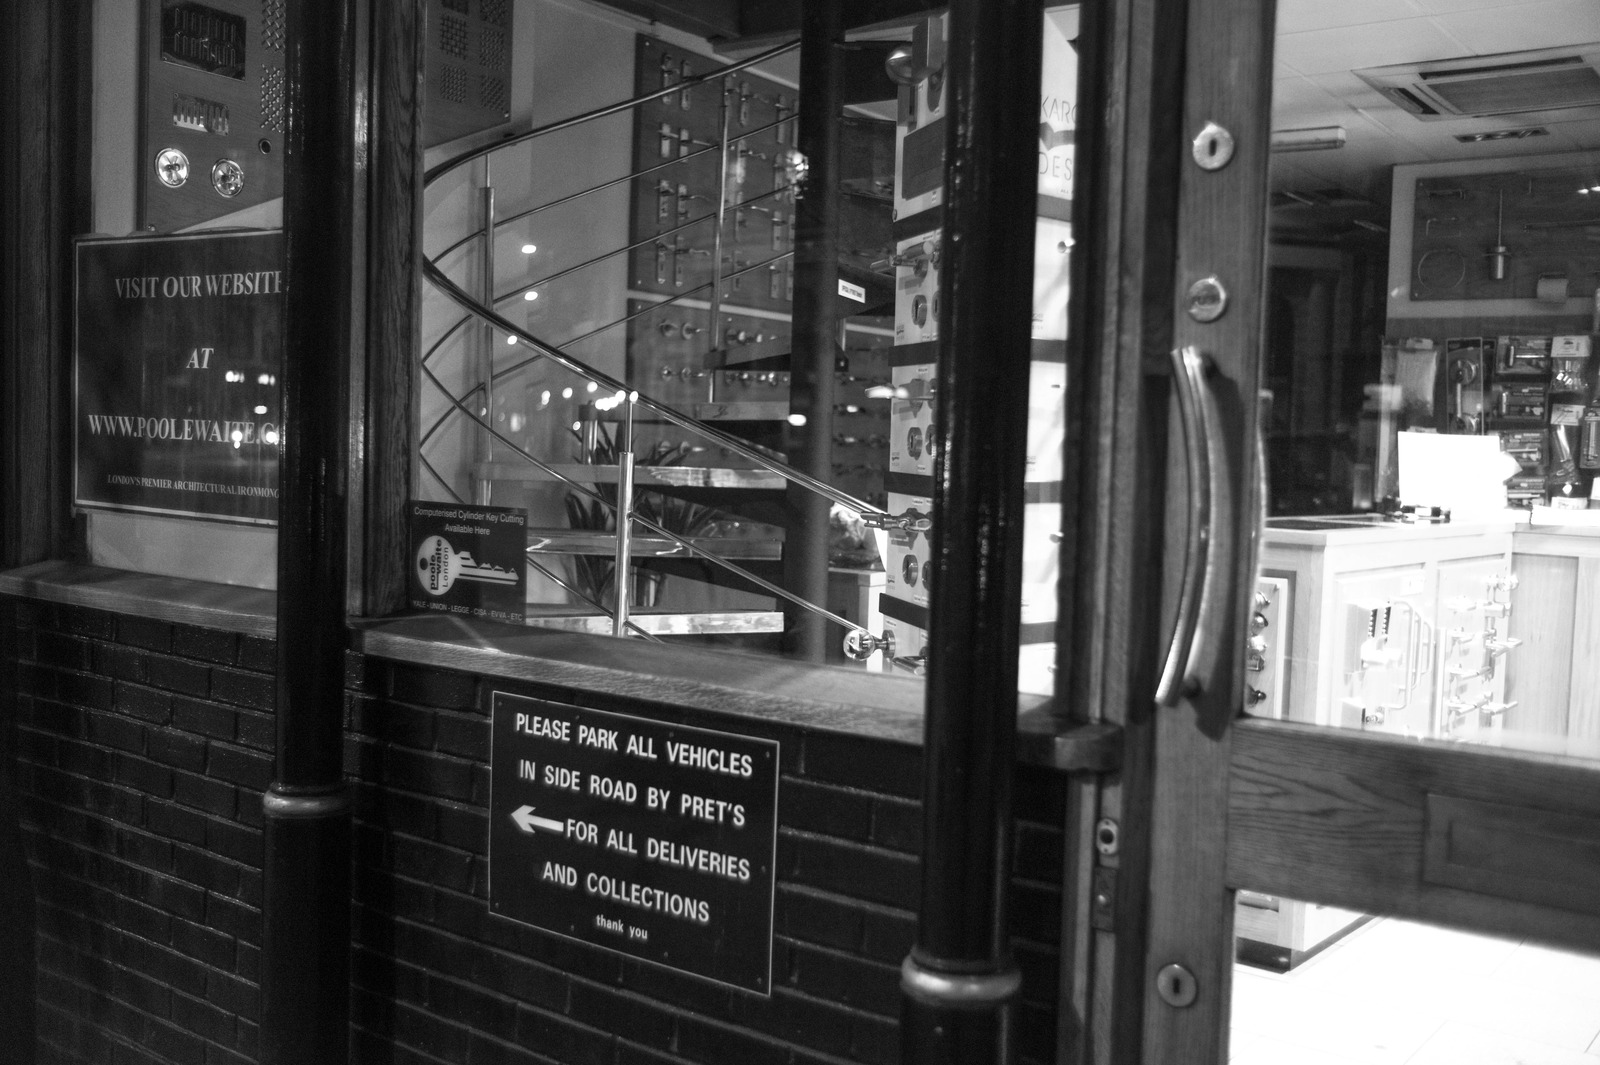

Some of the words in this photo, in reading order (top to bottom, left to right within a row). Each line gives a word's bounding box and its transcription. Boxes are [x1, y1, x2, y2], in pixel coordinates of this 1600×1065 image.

[115, 276, 159, 299] VISIT
[163, 275, 202, 298] OUR
[186, 348, 214, 369] AT
[107, 474, 141, 486] LONDON'S
[141, 477, 172, 489] PREMIER
[173, 479, 237, 495] ARCHITECTURAL
[414, 506, 457, 519] Computerised
[458, 510, 485, 521] Cylinder
[486, 512, 498, 523] Key
[500, 513, 524, 525] Cutting
[445, 523, 473, 534] Available
[474, 527, 490, 535] Here
[413, 600, 427, 608] YALE
[430, 602, 448, 610] UNION
[451, 605, 470, 614] LEGGE
[473, 608, 487, 616] CISA
[511, 612, 523, 621] ETC
[516, 712, 571, 742] PLEASE
[578, 724, 619, 751] PARK
[626, 734, 658, 759] ALL
[666, 740, 753, 777] VEHICLES
[519, 758, 536, 780] IN
[544, 764, 581, 791] SIDE
[590, 774, 638, 803] ROAD
[647, 786, 671, 810] BY
[681, 793, 746, 827] PRET'S
[566, 818, 598, 845] FOR
[606, 828, 638, 854] ALL
[647, 837, 751, 881] DELIVERIES
[542, 861, 578, 887] AND
[587, 872, 710, 923] COLLECTIONS
[596, 914, 624, 933] thank
[629, 924, 648, 940] you
